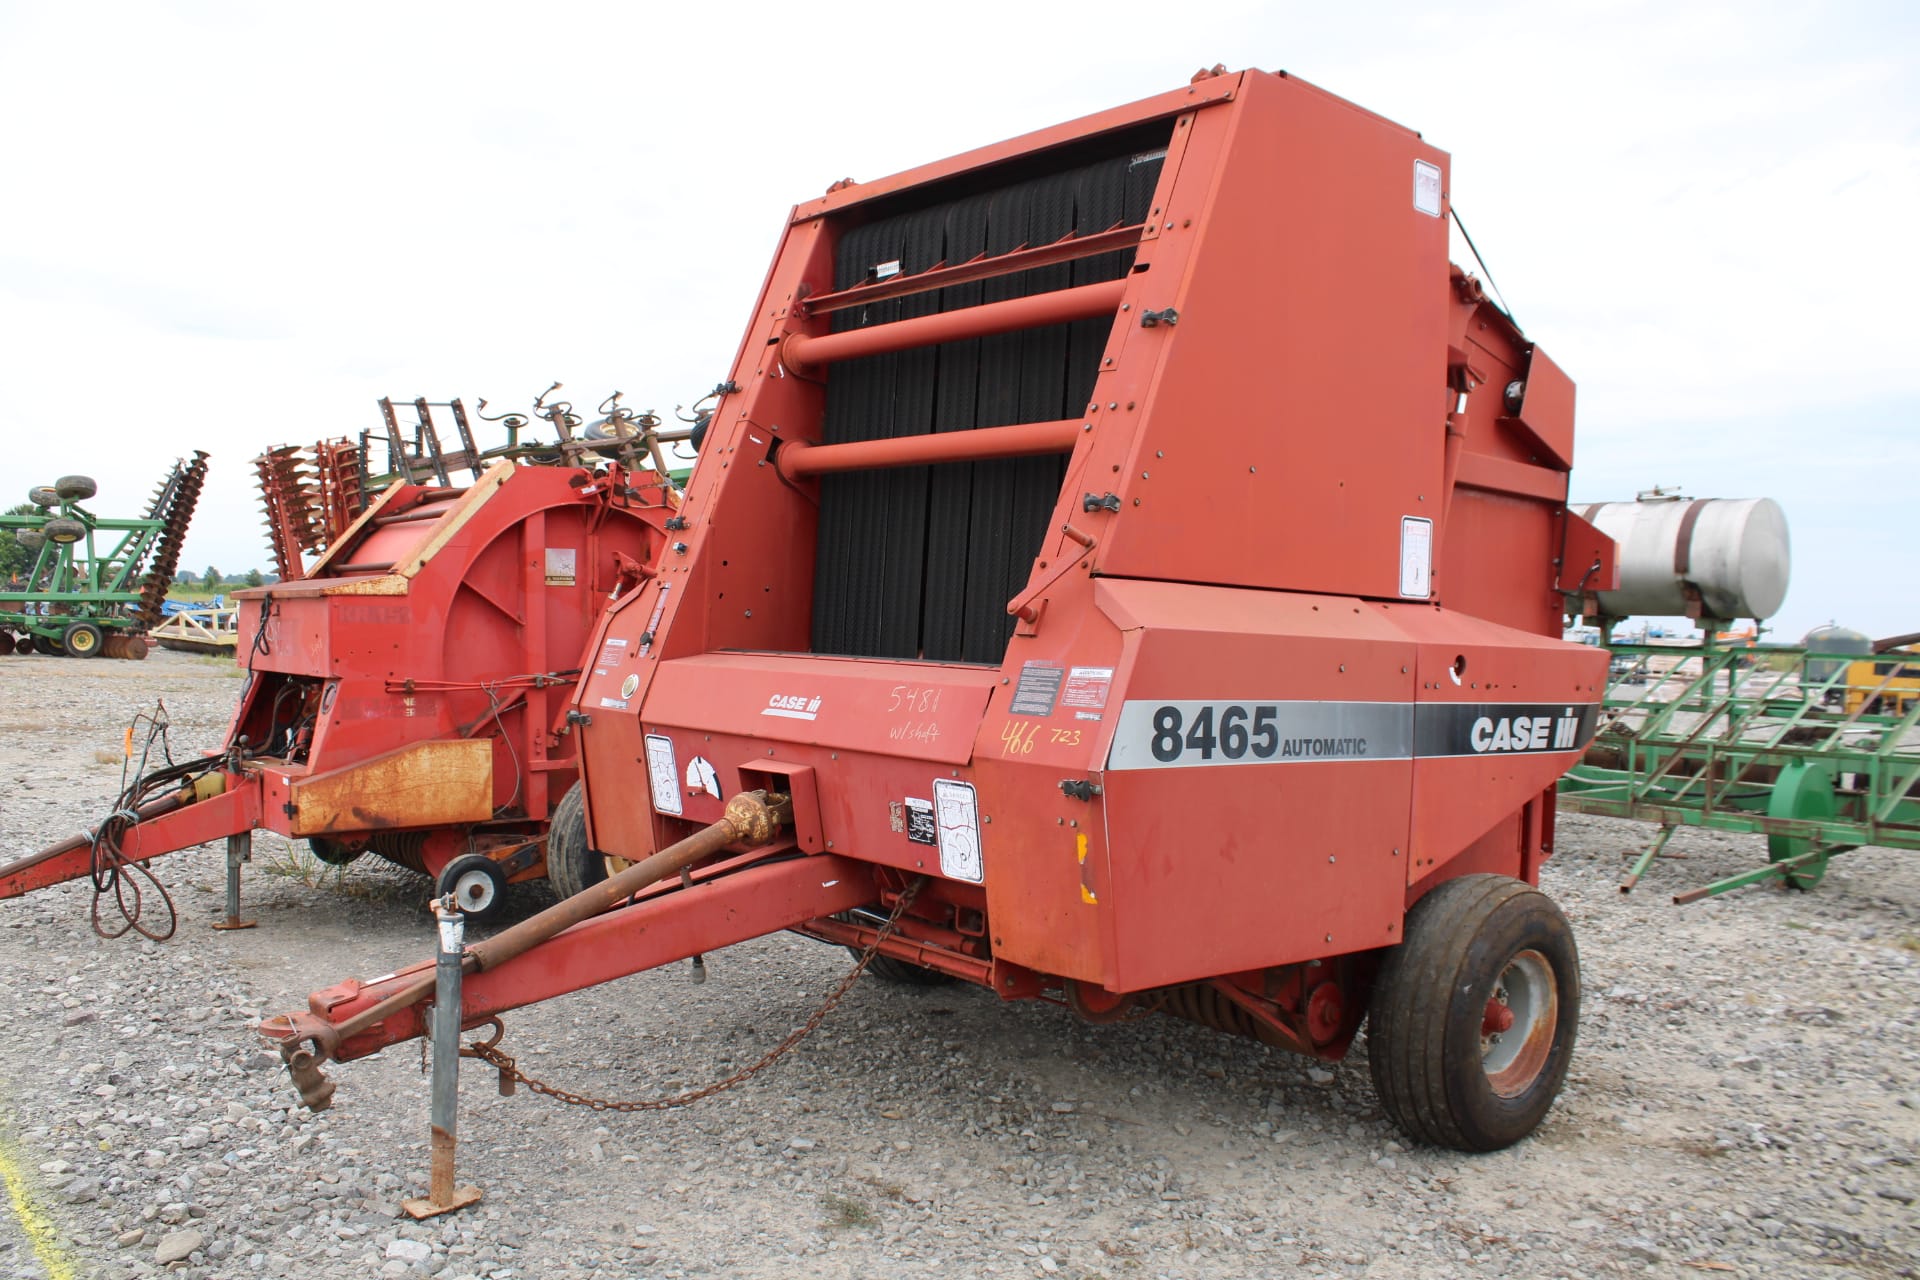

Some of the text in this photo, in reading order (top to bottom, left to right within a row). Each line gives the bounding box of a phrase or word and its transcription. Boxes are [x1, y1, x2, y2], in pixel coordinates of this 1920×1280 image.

[769, 694, 806, 711] CASE
[888, 685, 942, 713] 5481
[1001, 720, 1081, 758] 466 723
[1150, 705, 1367, 762] 8465 AUTOMATIC
[1470, 717, 1551, 752] CASE
